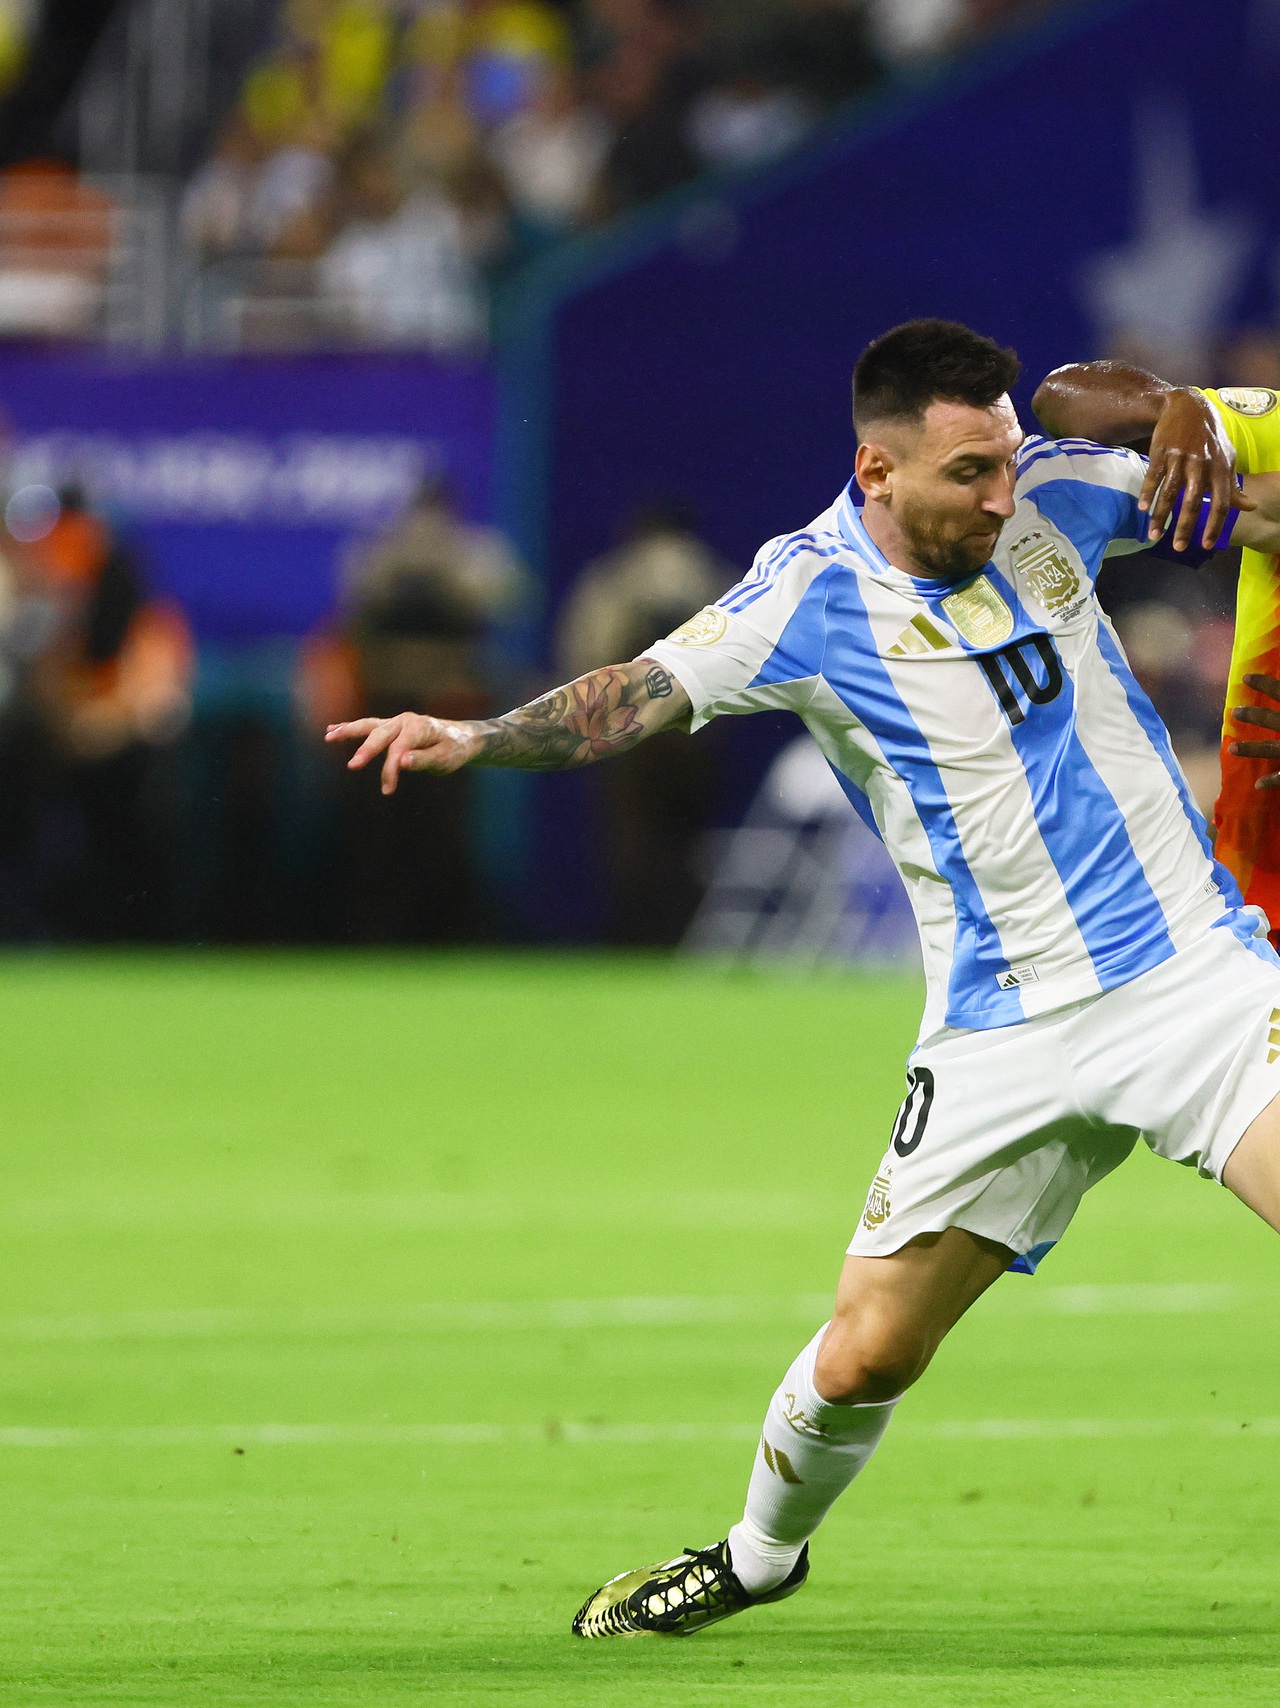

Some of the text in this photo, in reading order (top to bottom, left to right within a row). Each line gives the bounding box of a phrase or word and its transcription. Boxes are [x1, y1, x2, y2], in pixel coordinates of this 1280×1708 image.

[1031, 560, 1066, 592] AFA
[979, 633, 1063, 726] 10
[889, 1066, 935, 1158] 0
